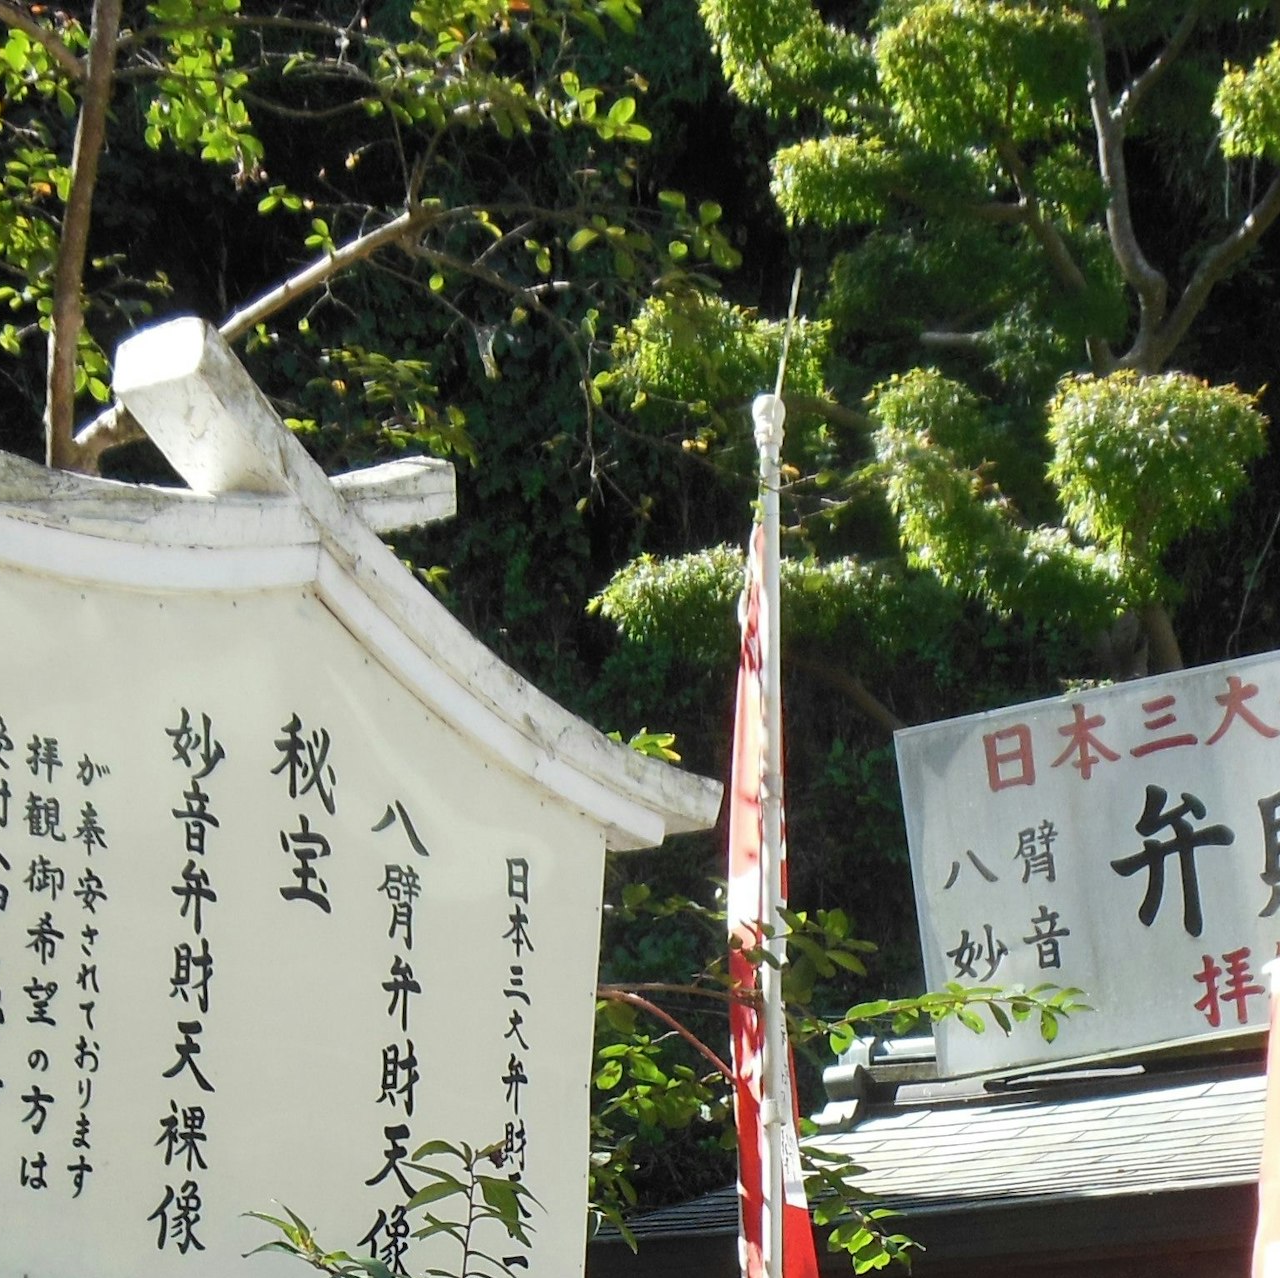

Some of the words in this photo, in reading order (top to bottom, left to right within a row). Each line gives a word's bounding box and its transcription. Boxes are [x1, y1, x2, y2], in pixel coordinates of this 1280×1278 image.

[20, 734, 66, 1191] 拝観御希望の方は
[66, 753, 111, 1198] が奉安されております
[147, 707, 224, 1254] 妙音弁財天裸像
[271, 713, 336, 913] 秘宝
[943, 819, 1059, 890] 八臂
[946, 905, 1070, 982] 妙音
[357, 799, 430, 1277] 八臂弁財天像
